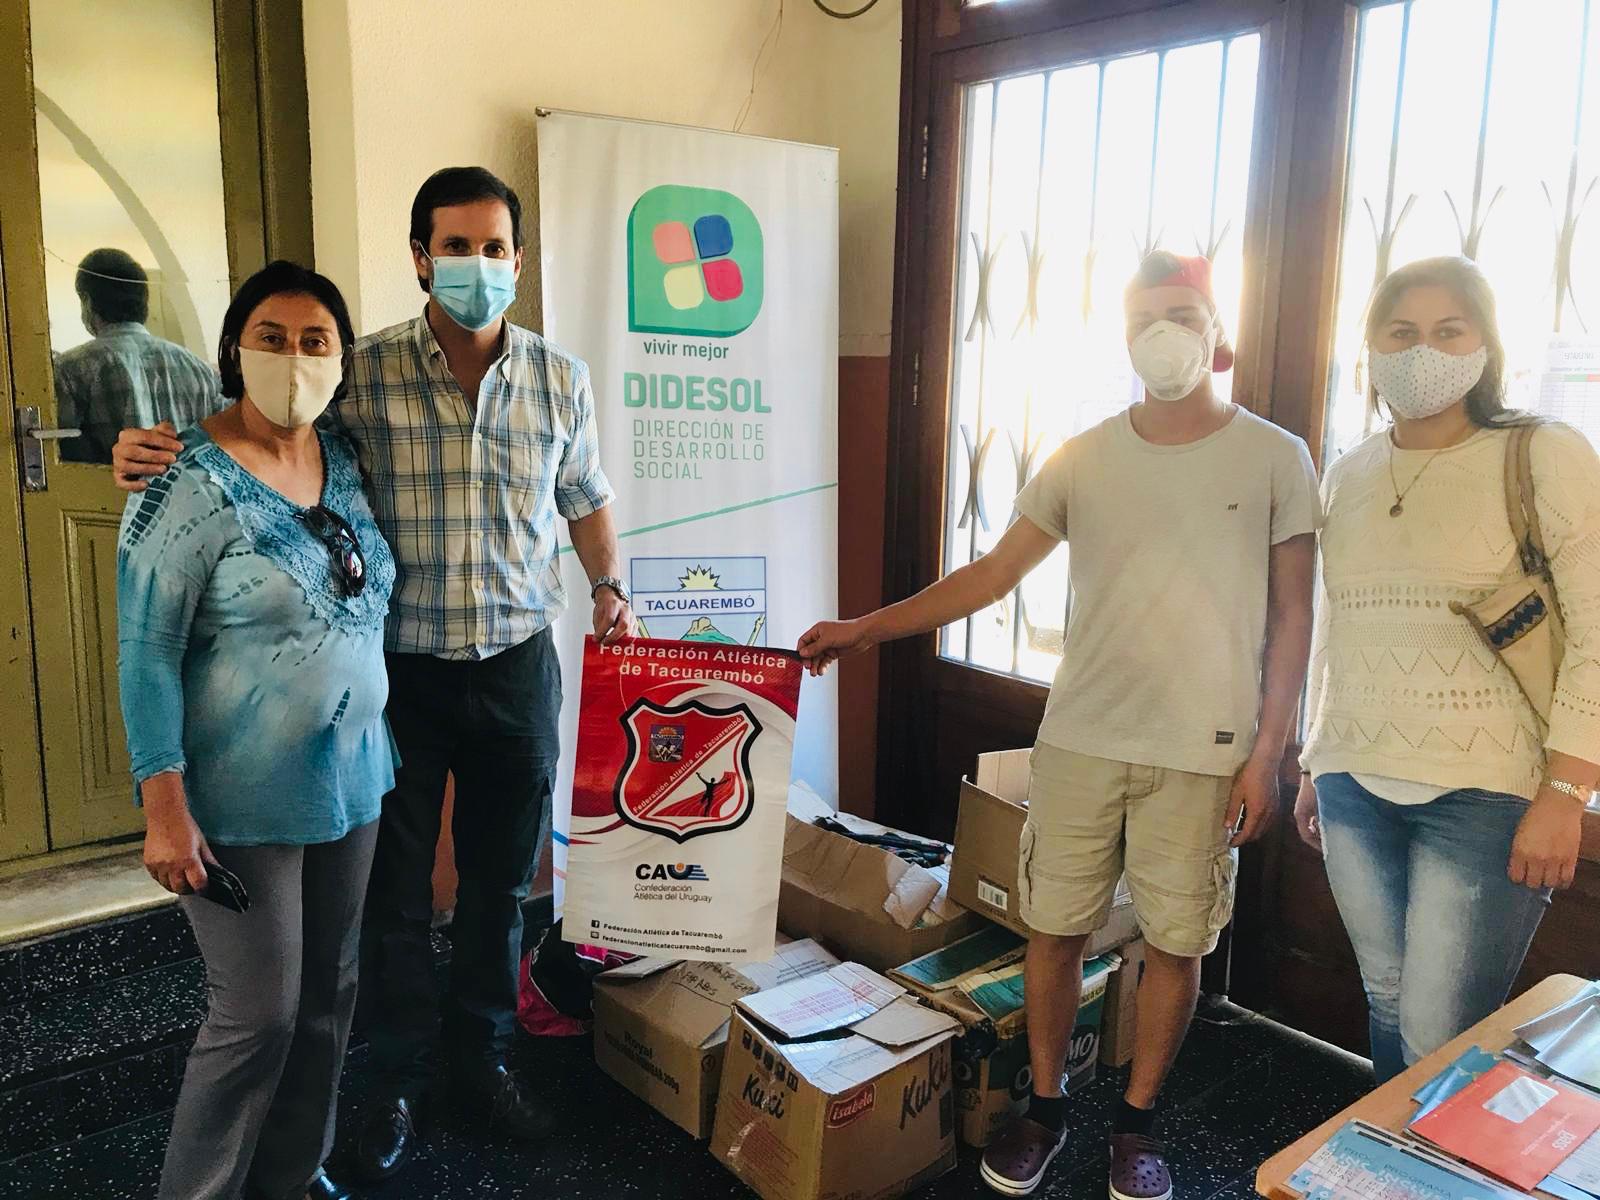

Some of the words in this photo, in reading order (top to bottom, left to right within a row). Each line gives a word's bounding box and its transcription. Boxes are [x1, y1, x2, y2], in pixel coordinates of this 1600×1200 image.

[643, 339, 678, 356] vivir
[682, 341, 729, 362] mejor
[623, 371, 772, 414] DIDESOL
[633, 418, 734, 440] DIRECCIÓN
[742, 422, 764, 441] DE
[633, 440, 764, 461] DESARROLLO
[633, 461, 703, 480] SOCIAL
[645, 594, 755, 613] TACUAREMBÓ
[600, 643, 708, 661] Federación
[712, 649, 787, 669] Atlética
[619, 662, 642, 675] de
[647, 662, 765, 685] Tacuarembó
[634, 883, 693, 892] Confederación
[679, 893, 713, 904] Uruguay
[603, 923, 642, 935] Federación
[681, 930, 723, 940] Tacuarembó
